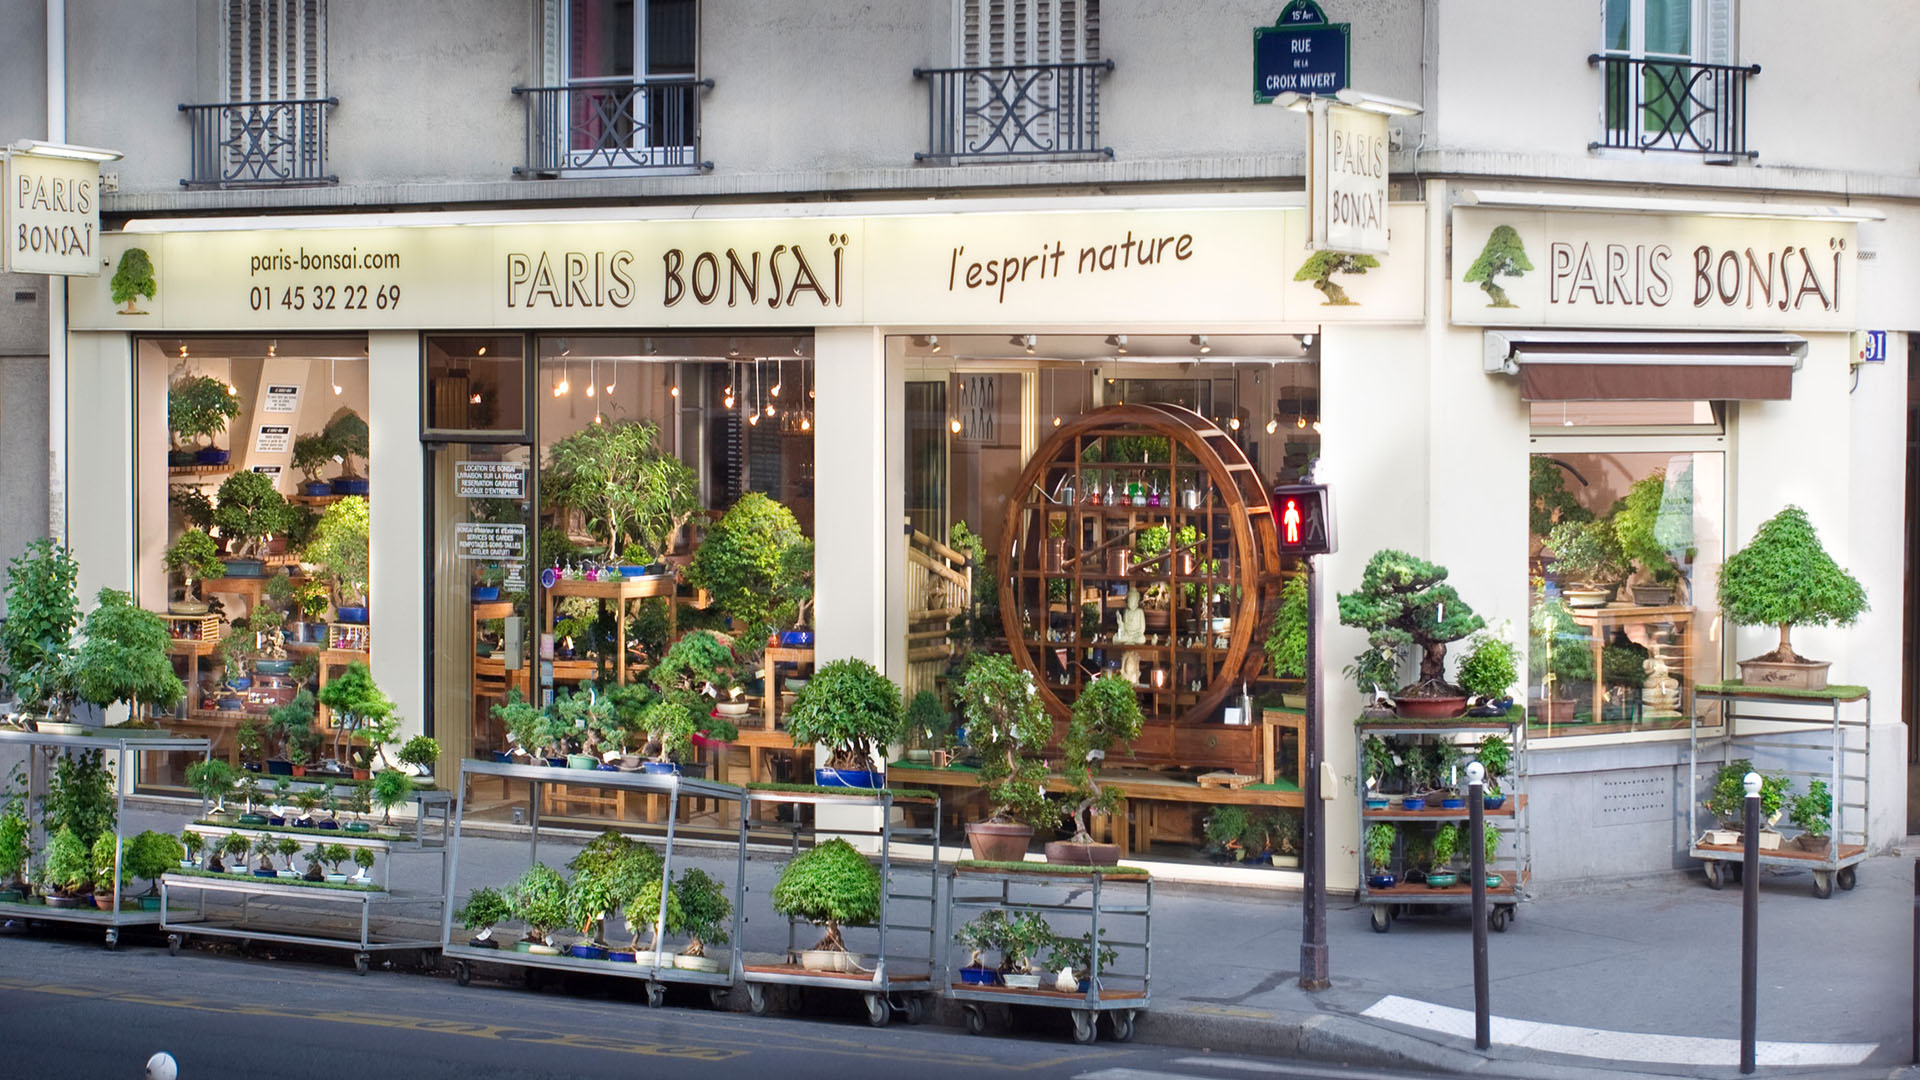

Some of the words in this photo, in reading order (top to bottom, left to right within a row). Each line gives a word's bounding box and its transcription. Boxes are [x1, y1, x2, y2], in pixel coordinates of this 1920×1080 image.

[1291, 38, 1311, 53] RUE
[1293, 59, 1301, 68] DE
[1302, 58, 1309, 68] LA
[1266, 75, 1297, 90] CROIX
[1300, 72, 1337, 88] NIVERT
[1334, 130, 1383, 179] PARIS
[18, 174, 91, 215] PARIS
[1333, 189, 1384, 232] BONSAÏ
[18, 222, 93, 257] BONSAÏ
[250, 246, 401, 277] paris-bonsai.com
[507, 250, 636, 308] PARIS
[662, 232, 850, 309] BONSAÏ
[949, 240, 1066, 304] l'esprit
[1078, 230, 1194, 275] nature
[1550, 241, 1674, 308] PARIS
[1692, 236, 1847, 313] BONSAÏ
[250, 286, 271, 311] 01
[281, 286, 305, 311] 45
[313, 285, 336, 310] 32
[344, 285, 368, 310] 22
[376, 284, 401, 310] 69
